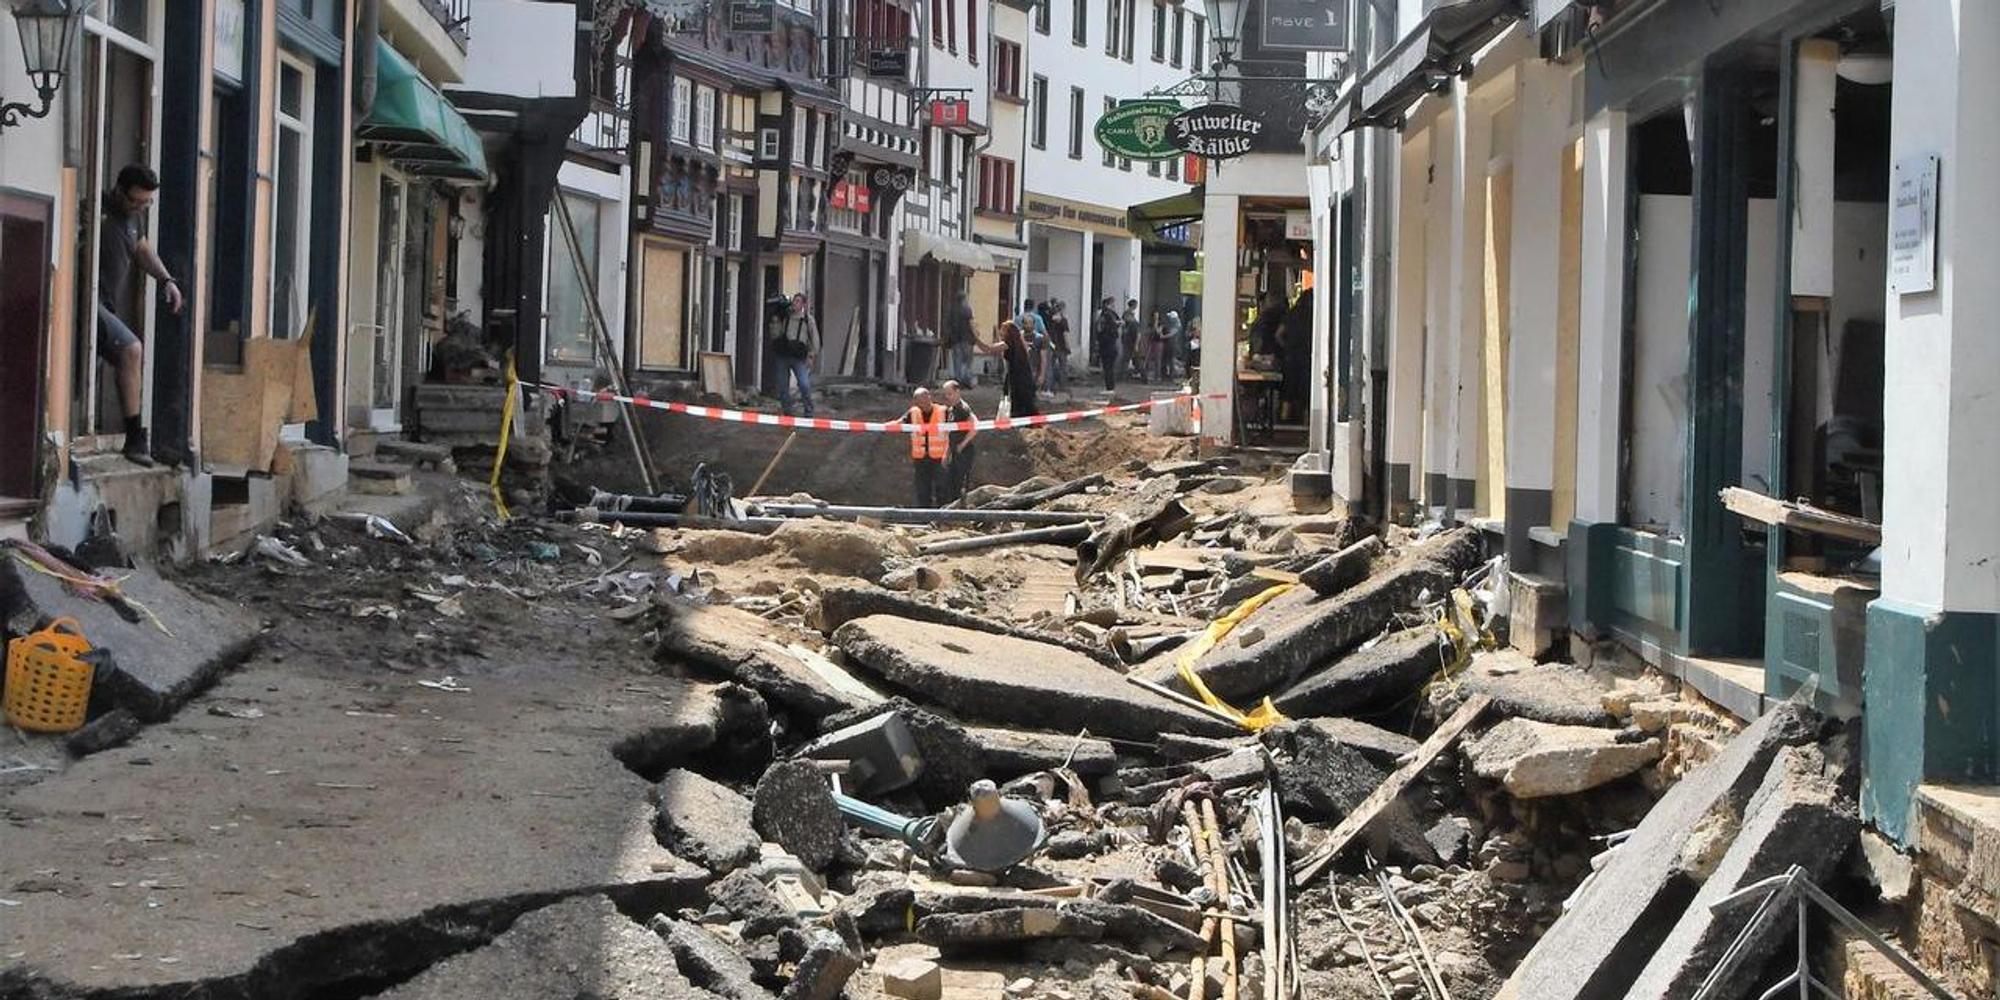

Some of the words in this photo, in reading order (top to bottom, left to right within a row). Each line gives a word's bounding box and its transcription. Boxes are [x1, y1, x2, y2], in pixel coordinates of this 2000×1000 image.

[1324, 8, 1338, 26] 1
[1173, 113, 1262, 139] Juwelier
[1186, 135, 1252, 155] Kälble
